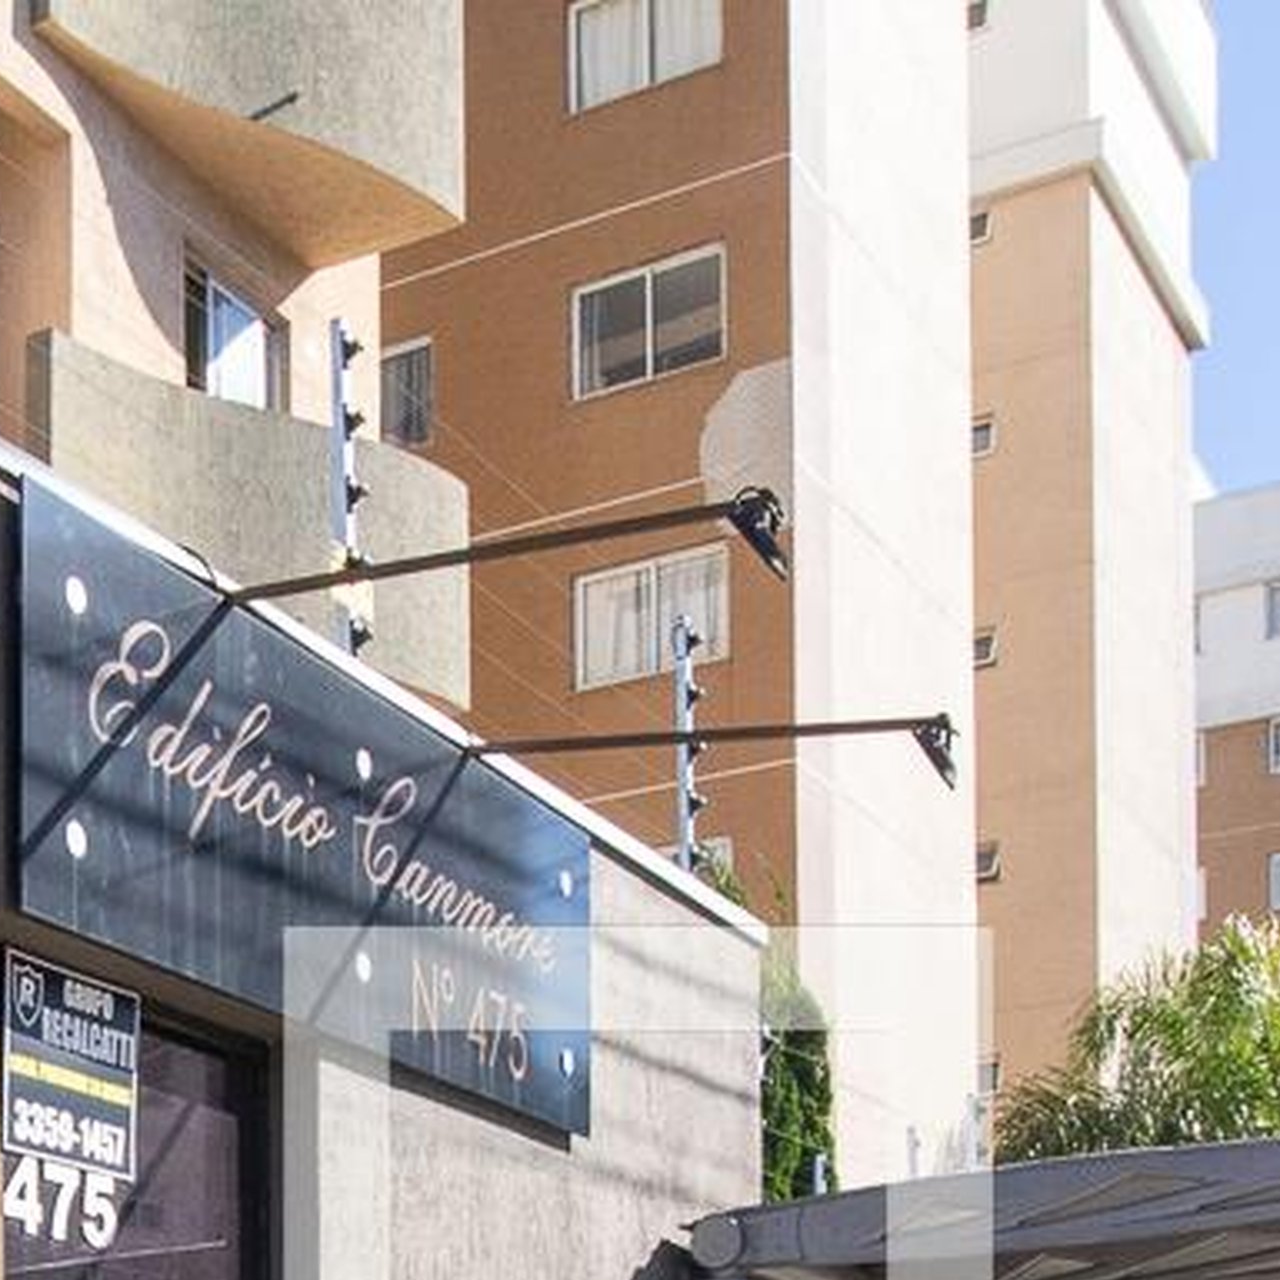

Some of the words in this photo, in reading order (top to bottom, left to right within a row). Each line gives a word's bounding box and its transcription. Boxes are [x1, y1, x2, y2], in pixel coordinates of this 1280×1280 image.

[63, 979, 114, 1021] GRUPO
[468, 985, 532, 1080] 475
[4, 1156, 118, 1250] 475
